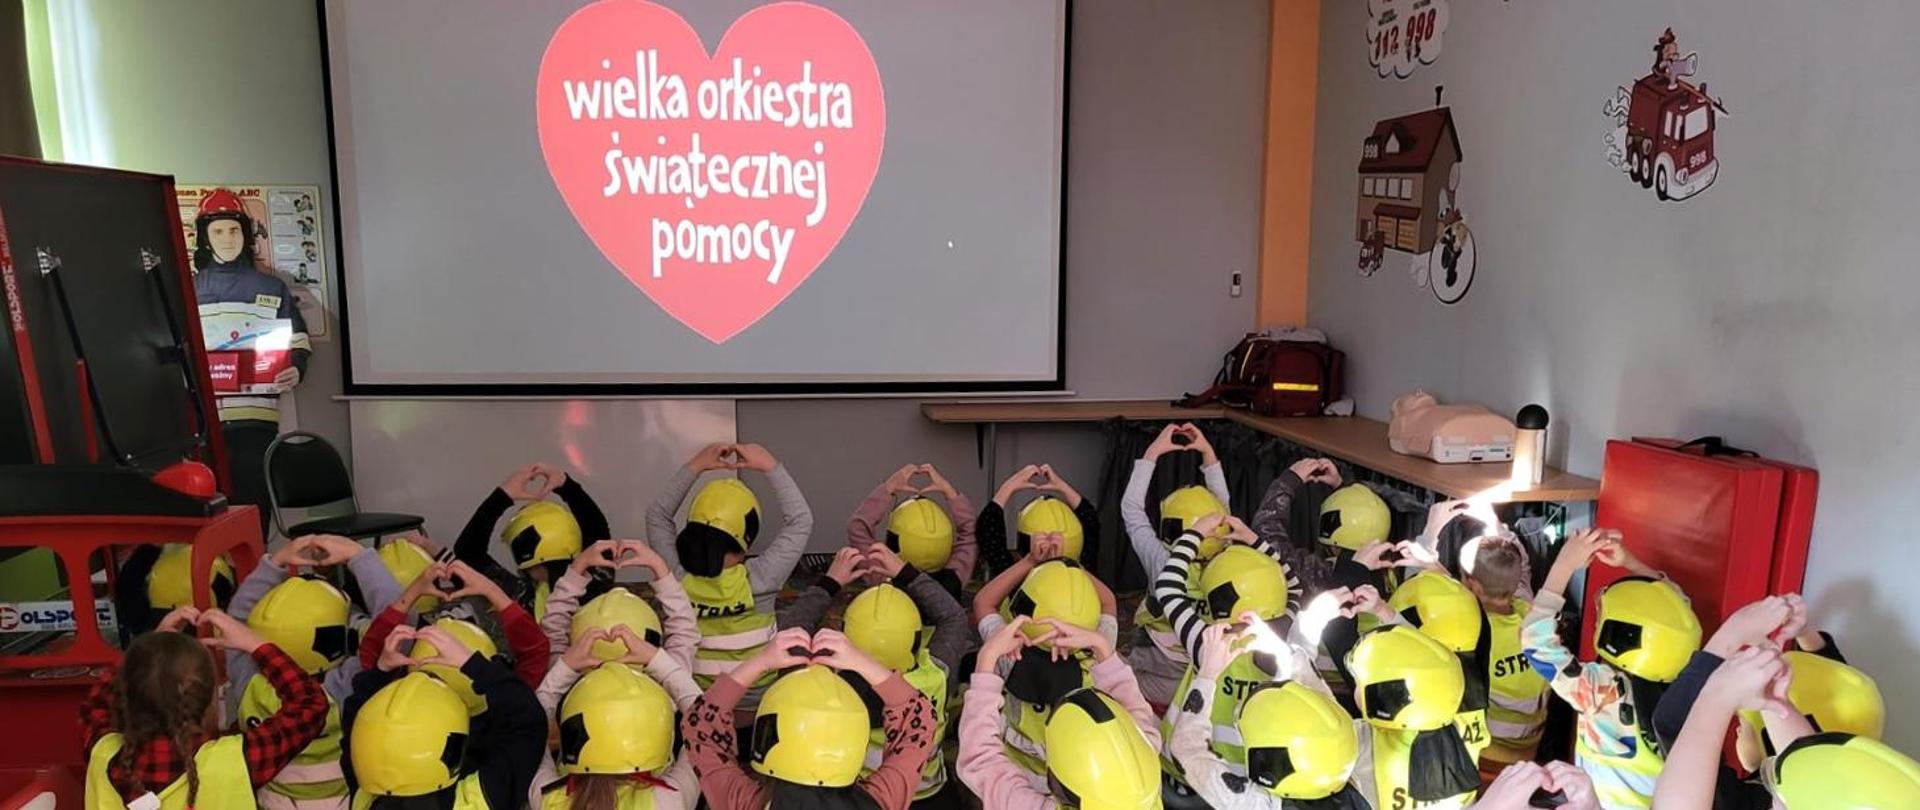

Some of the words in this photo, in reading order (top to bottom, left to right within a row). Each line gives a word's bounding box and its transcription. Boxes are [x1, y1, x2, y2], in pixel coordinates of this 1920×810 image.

[1406, 8, 1437, 48] 998
[563, 49, 689, 120] wielka
[697, 57, 853, 128] orkiestra
[603, 131, 826, 227] świątecznej
[1690, 150, 1707, 168] 998
[652, 217, 795, 284] pomocy
